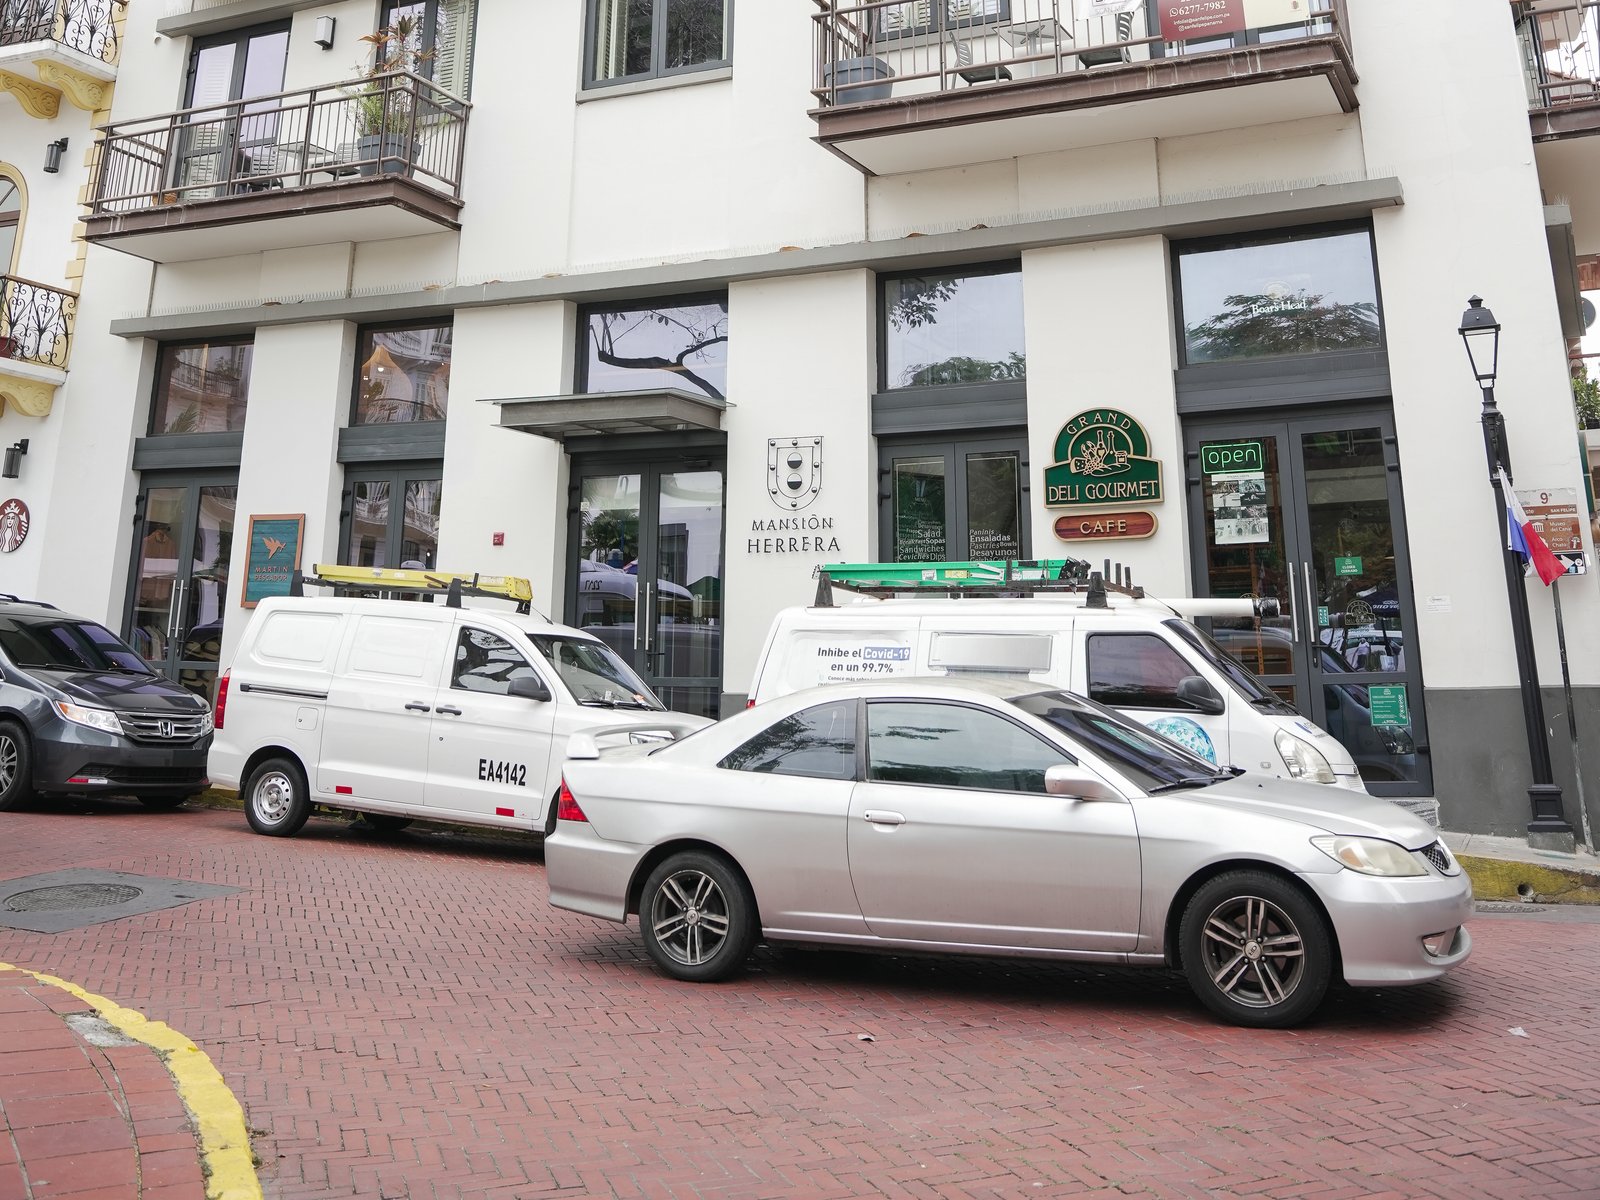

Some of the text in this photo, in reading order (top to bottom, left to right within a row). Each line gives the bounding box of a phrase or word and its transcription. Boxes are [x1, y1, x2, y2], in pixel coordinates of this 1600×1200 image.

[1095, 7, 1113, 15] SCAN
[1179, 0, 1226, 15] 6277-7982
[1066, 412, 1132, 435] GRAND
[1208, 449, 1257, 468] open
[1048, 480, 1158, 501] DELI GOURMET
[1079, 519, 1127, 534] CAFE
[918, 528, 941, 538] Salad
[970, 534, 1011, 542] Ensaladas
[747, 536, 841, 553] HERRERA
[900, 544, 944, 554] Sandwiches
[930, 552, 946, 562] Dips
[970, 549, 1017, 558] Desayunos
[818, 648, 910, 659] Inhibe el Covid-19
[846, 664, 859, 672] un
[862, 663, 894, 673] 99.7%
[478, 758, 526, 786] EA4142
